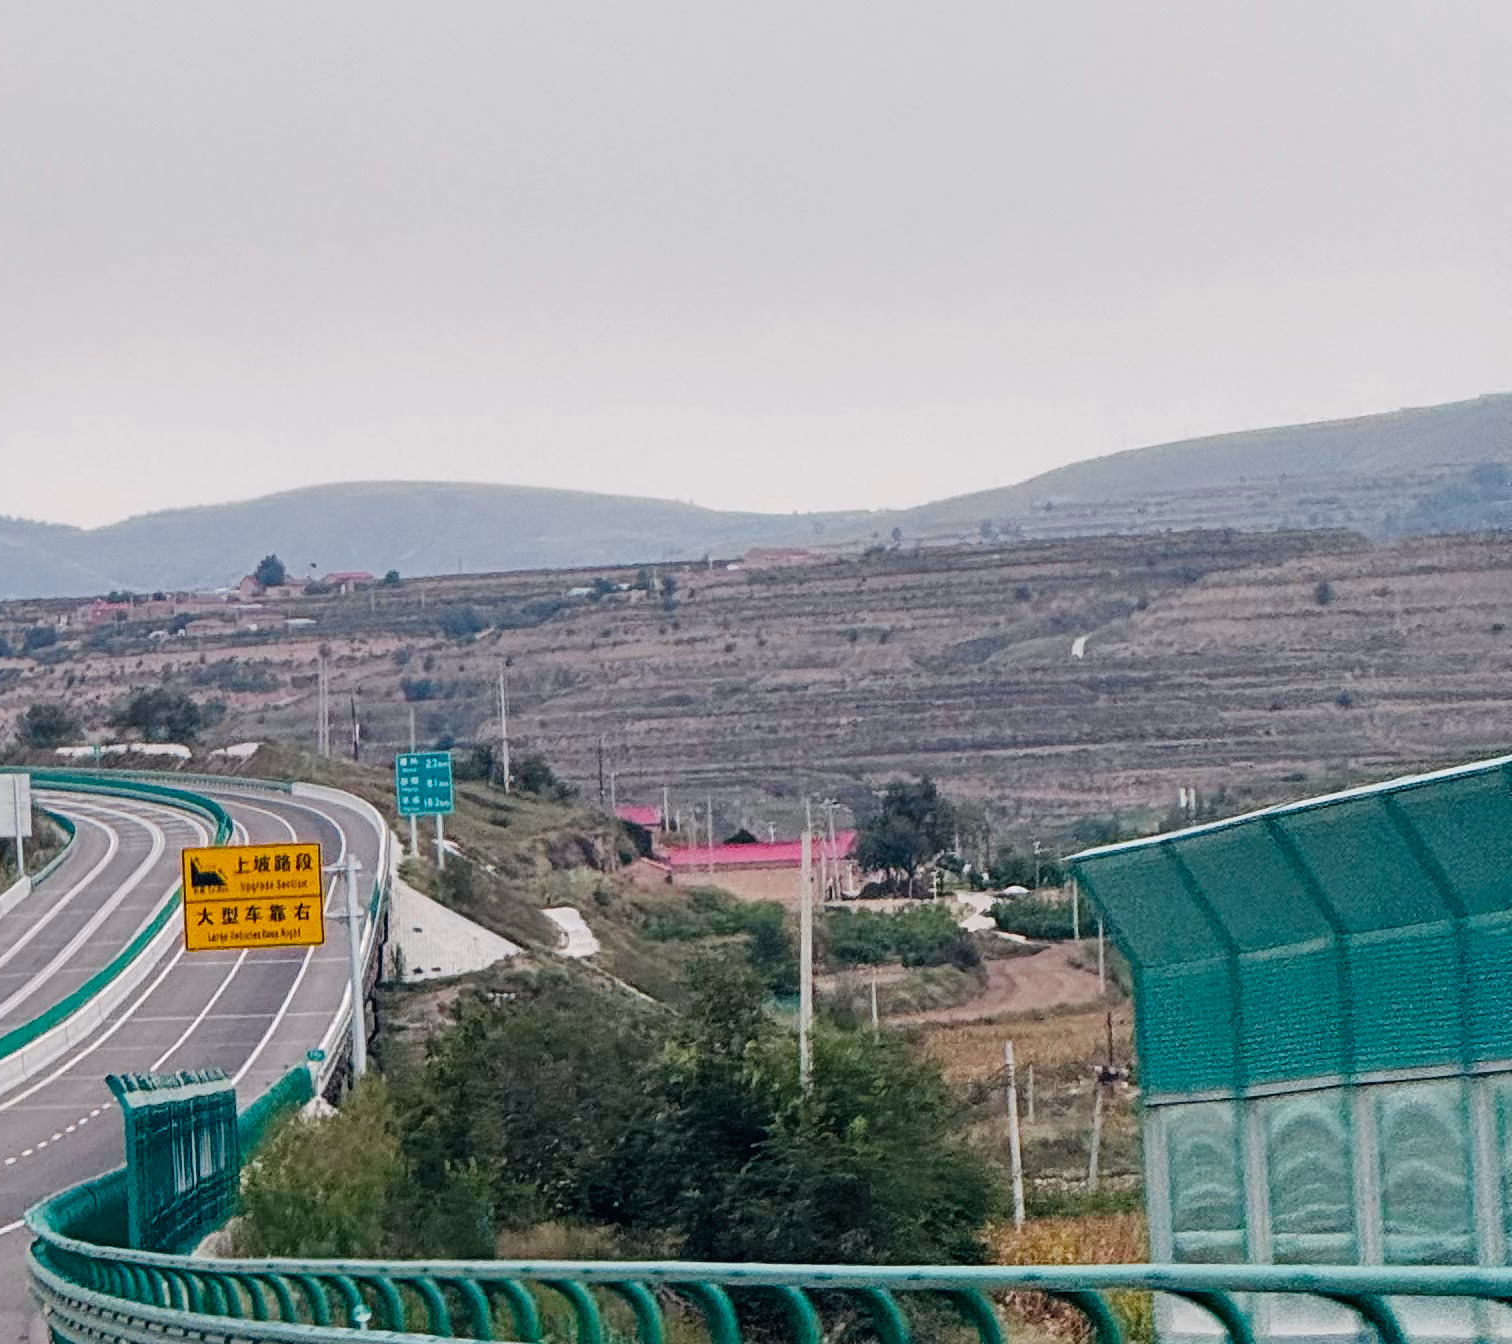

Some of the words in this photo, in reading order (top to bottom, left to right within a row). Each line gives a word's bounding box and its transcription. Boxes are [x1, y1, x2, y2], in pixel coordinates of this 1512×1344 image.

[235, 853, 313, 874] 上坡路段
[197, 902, 311, 926] 大型车靠右
